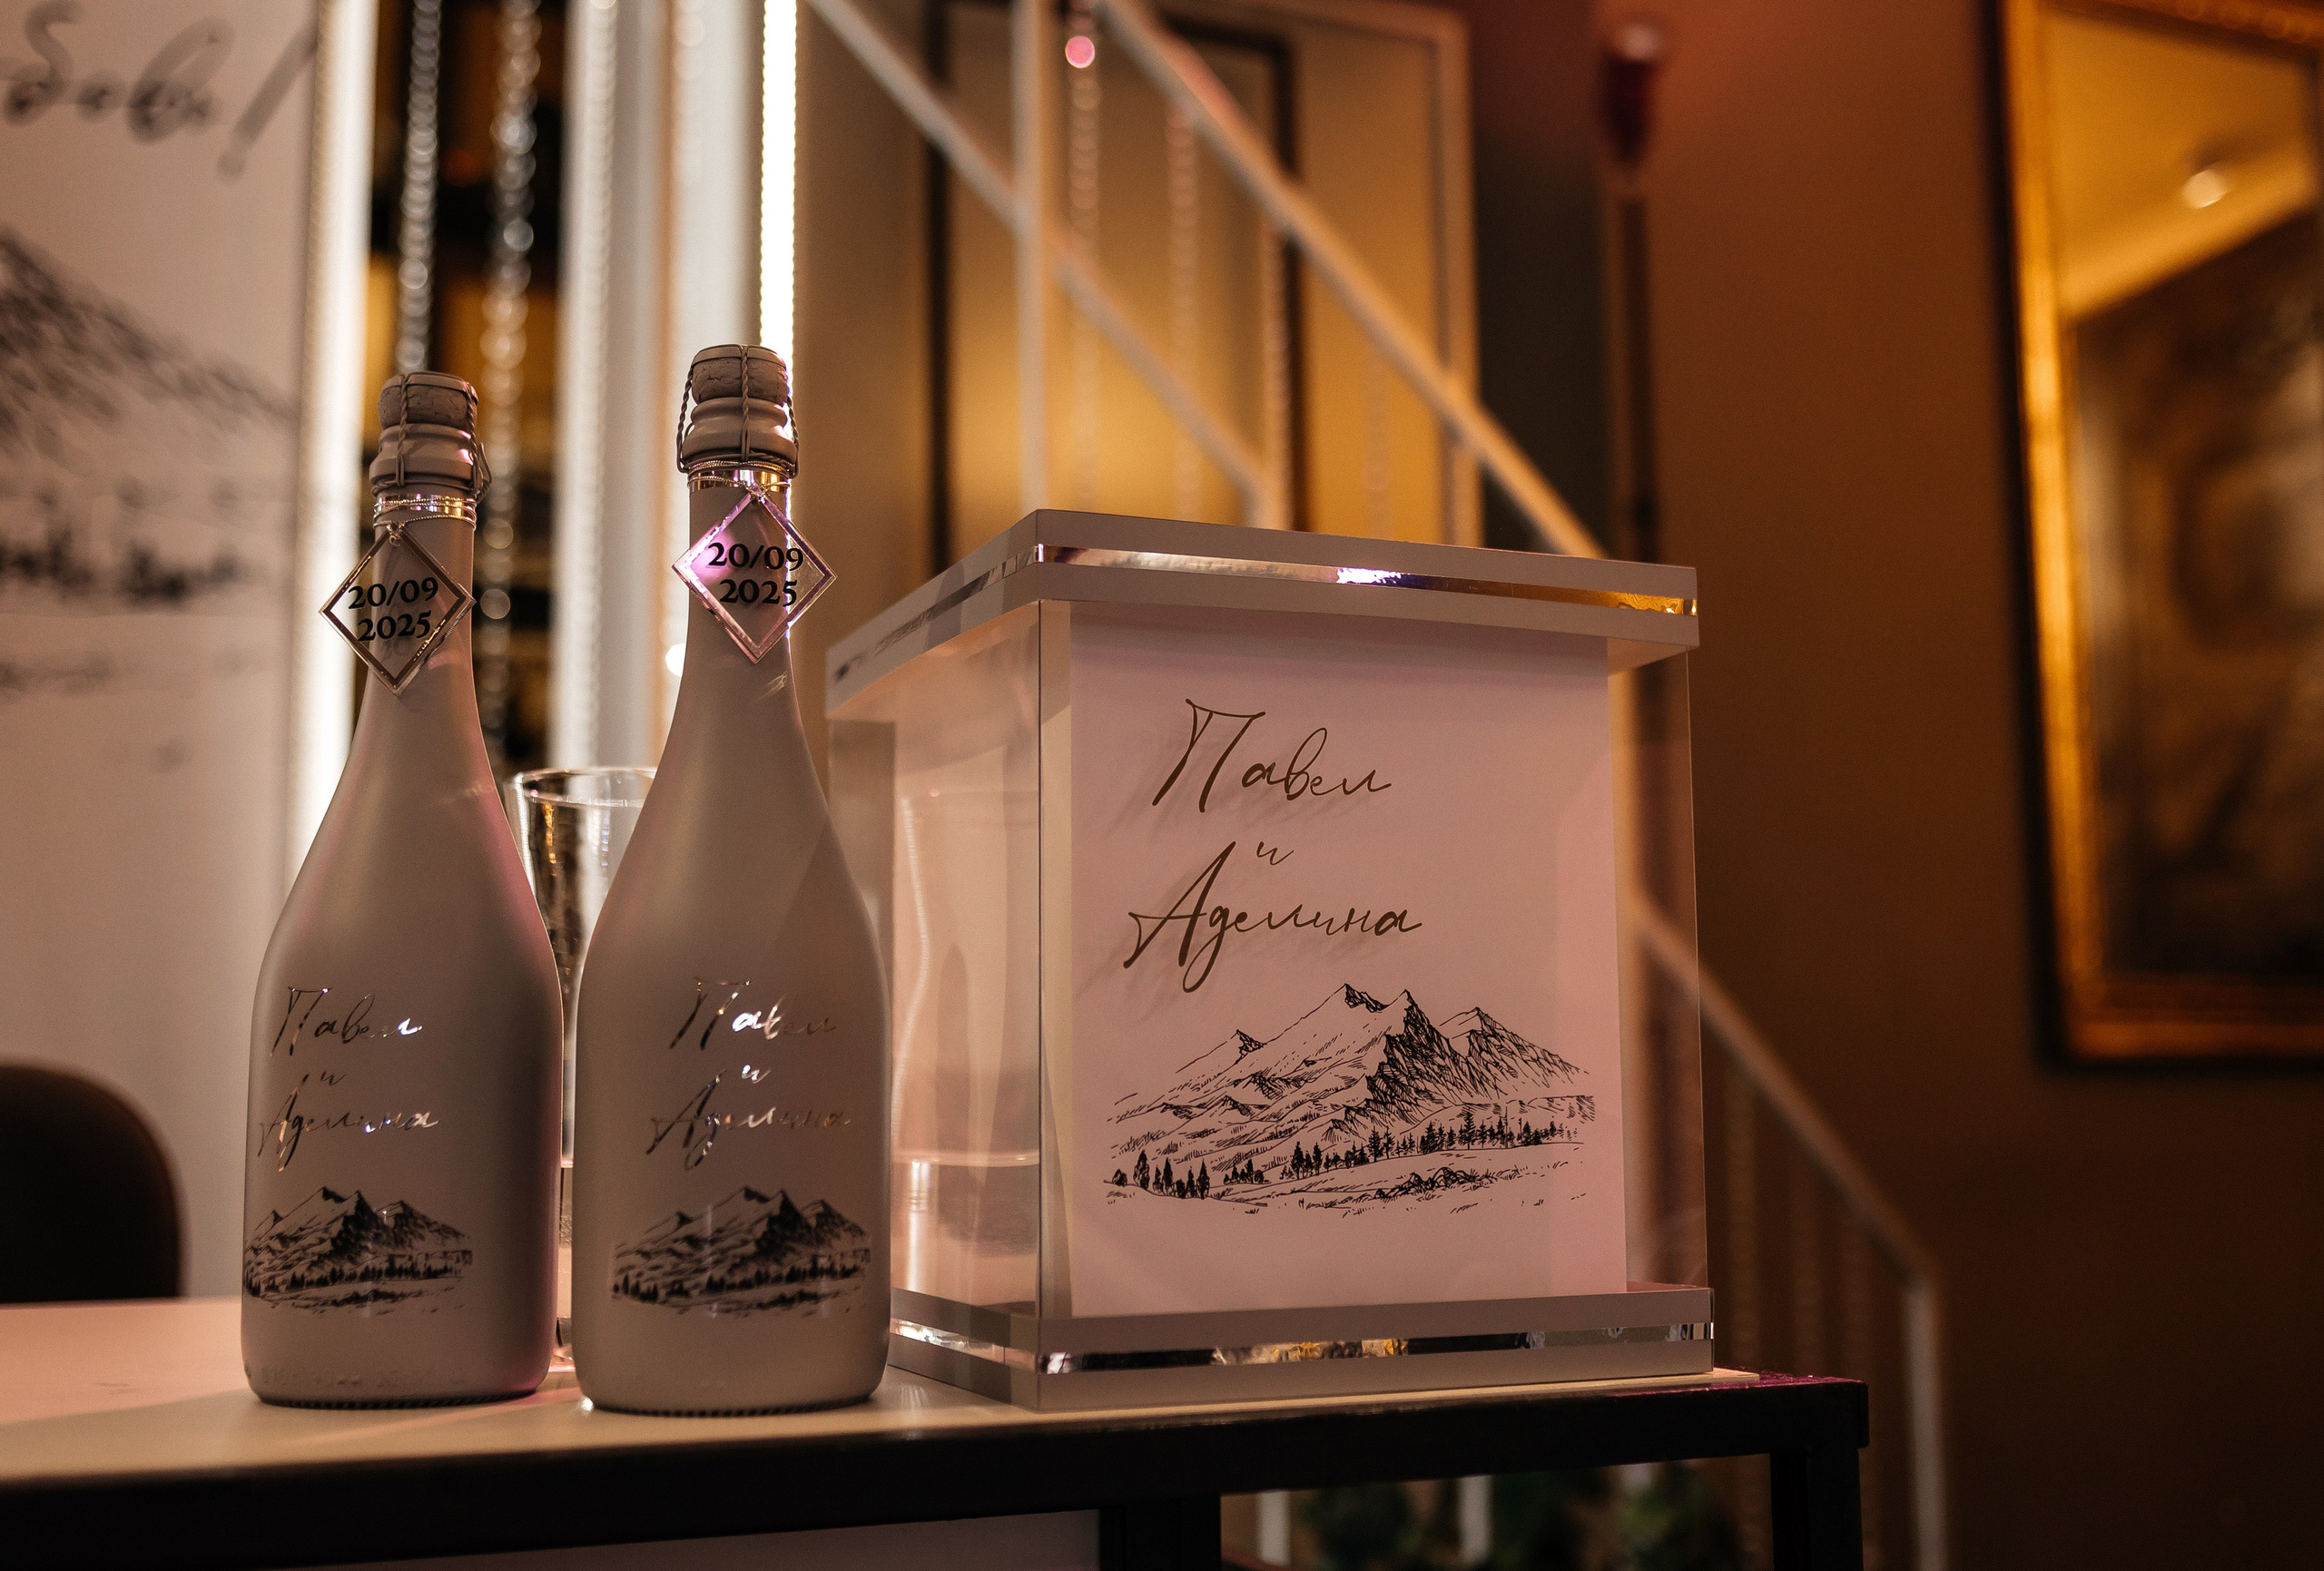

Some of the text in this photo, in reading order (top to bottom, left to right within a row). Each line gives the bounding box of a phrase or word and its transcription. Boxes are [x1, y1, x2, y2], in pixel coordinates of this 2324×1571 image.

[708, 542, 803, 572] 20/09
[348, 576, 438, 609] 20/09
[719, 579, 797, 607] 2025
[358, 610, 431, 641] 2025
[1152, 698, 1393, 813] Павел
[1122, 840, 1423, 993] Аделина
